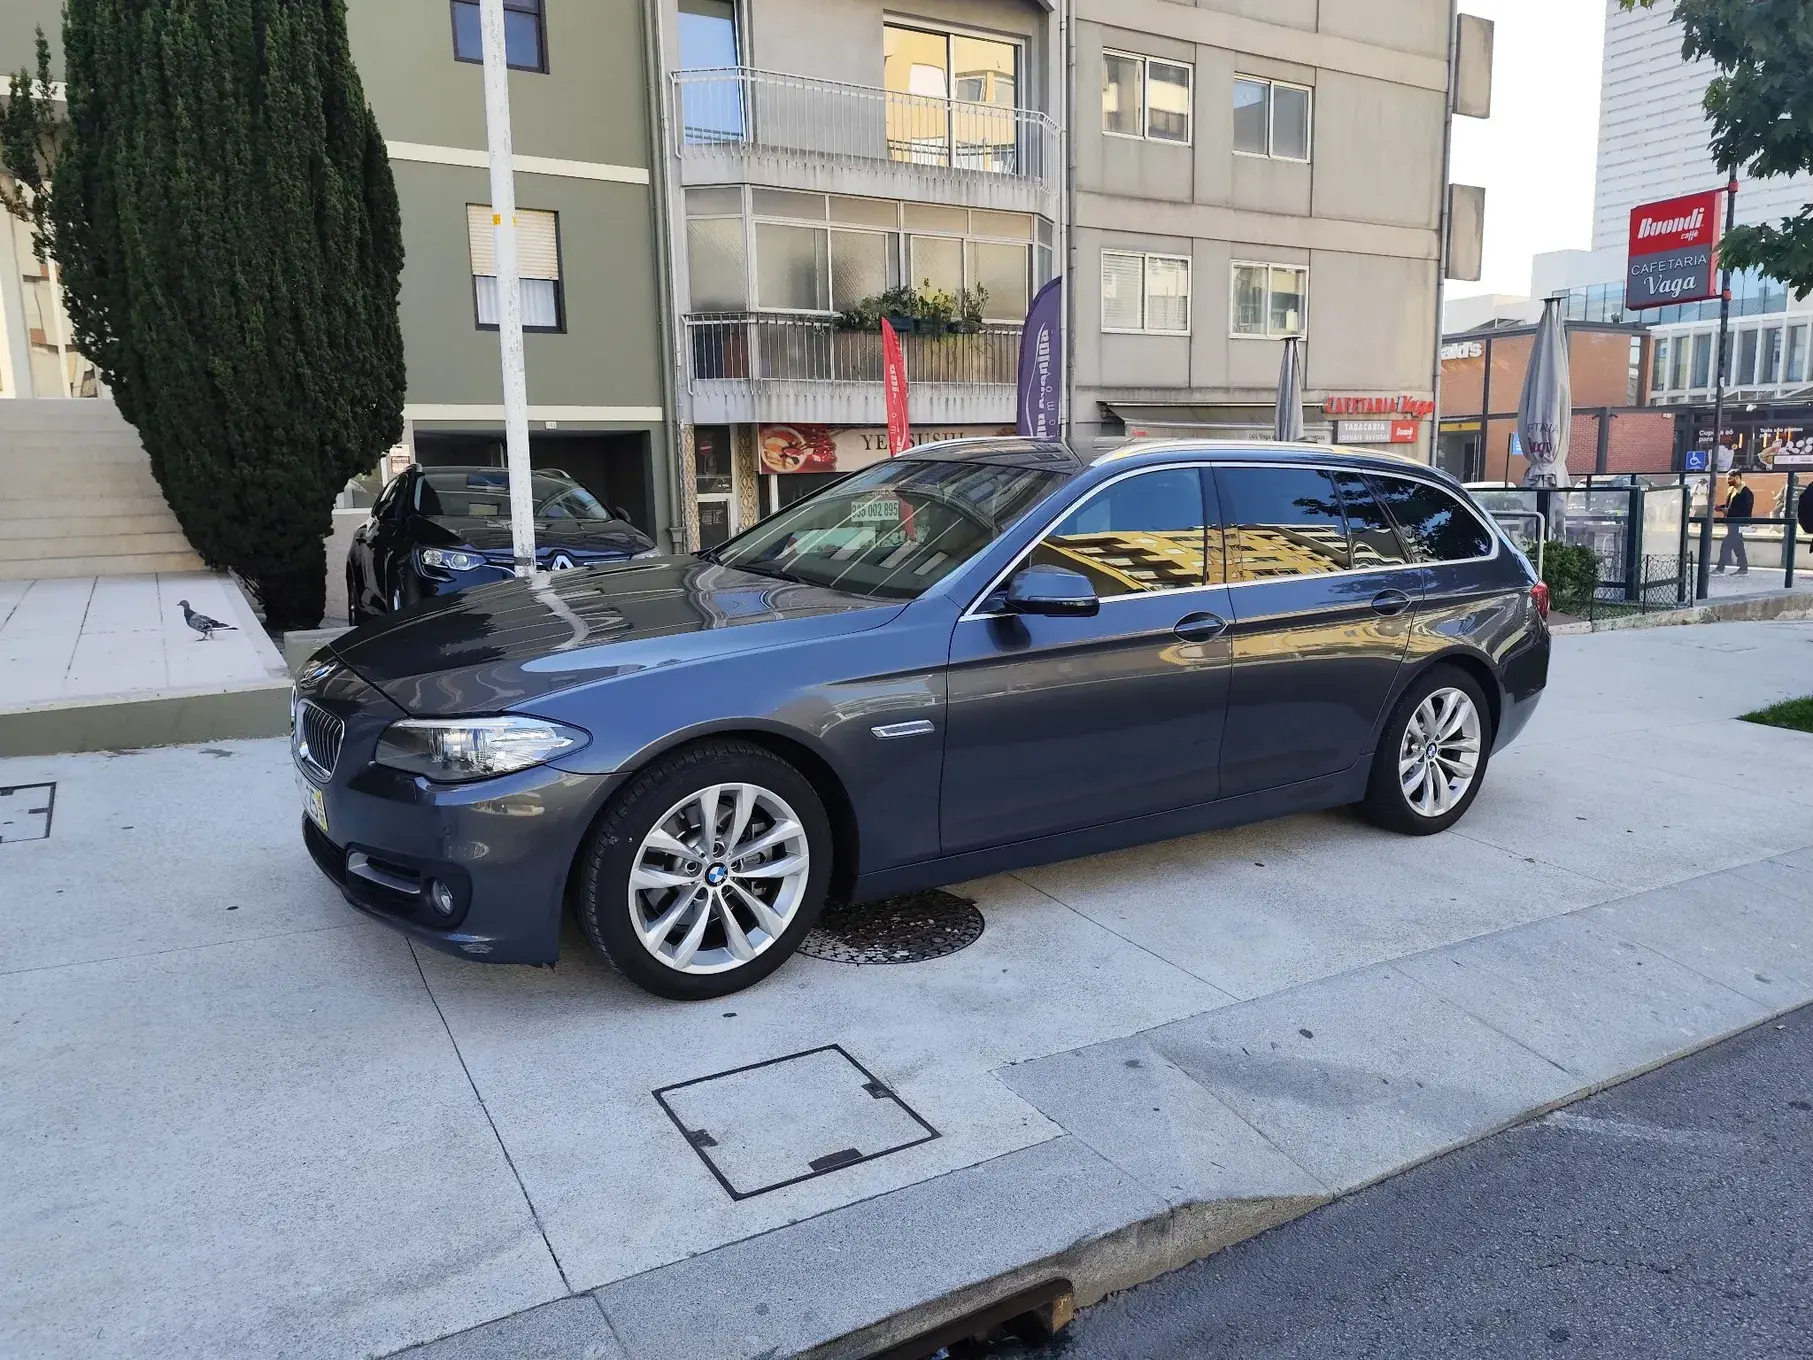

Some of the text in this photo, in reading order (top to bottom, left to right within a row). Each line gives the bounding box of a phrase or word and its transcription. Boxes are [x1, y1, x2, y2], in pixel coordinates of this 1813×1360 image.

[1637, 207, 1705, 239] Buondi
[1631, 254, 1707, 276] CAFETARIA
[1643, 275, 1697, 298] Vaga
[1326, 395, 1434, 418] CAFETARIA Vaga
[1345, 423, 1385, 431] TABACARIA
[860, 434, 888, 450] YE
[884, 502, 898, 517] 895
